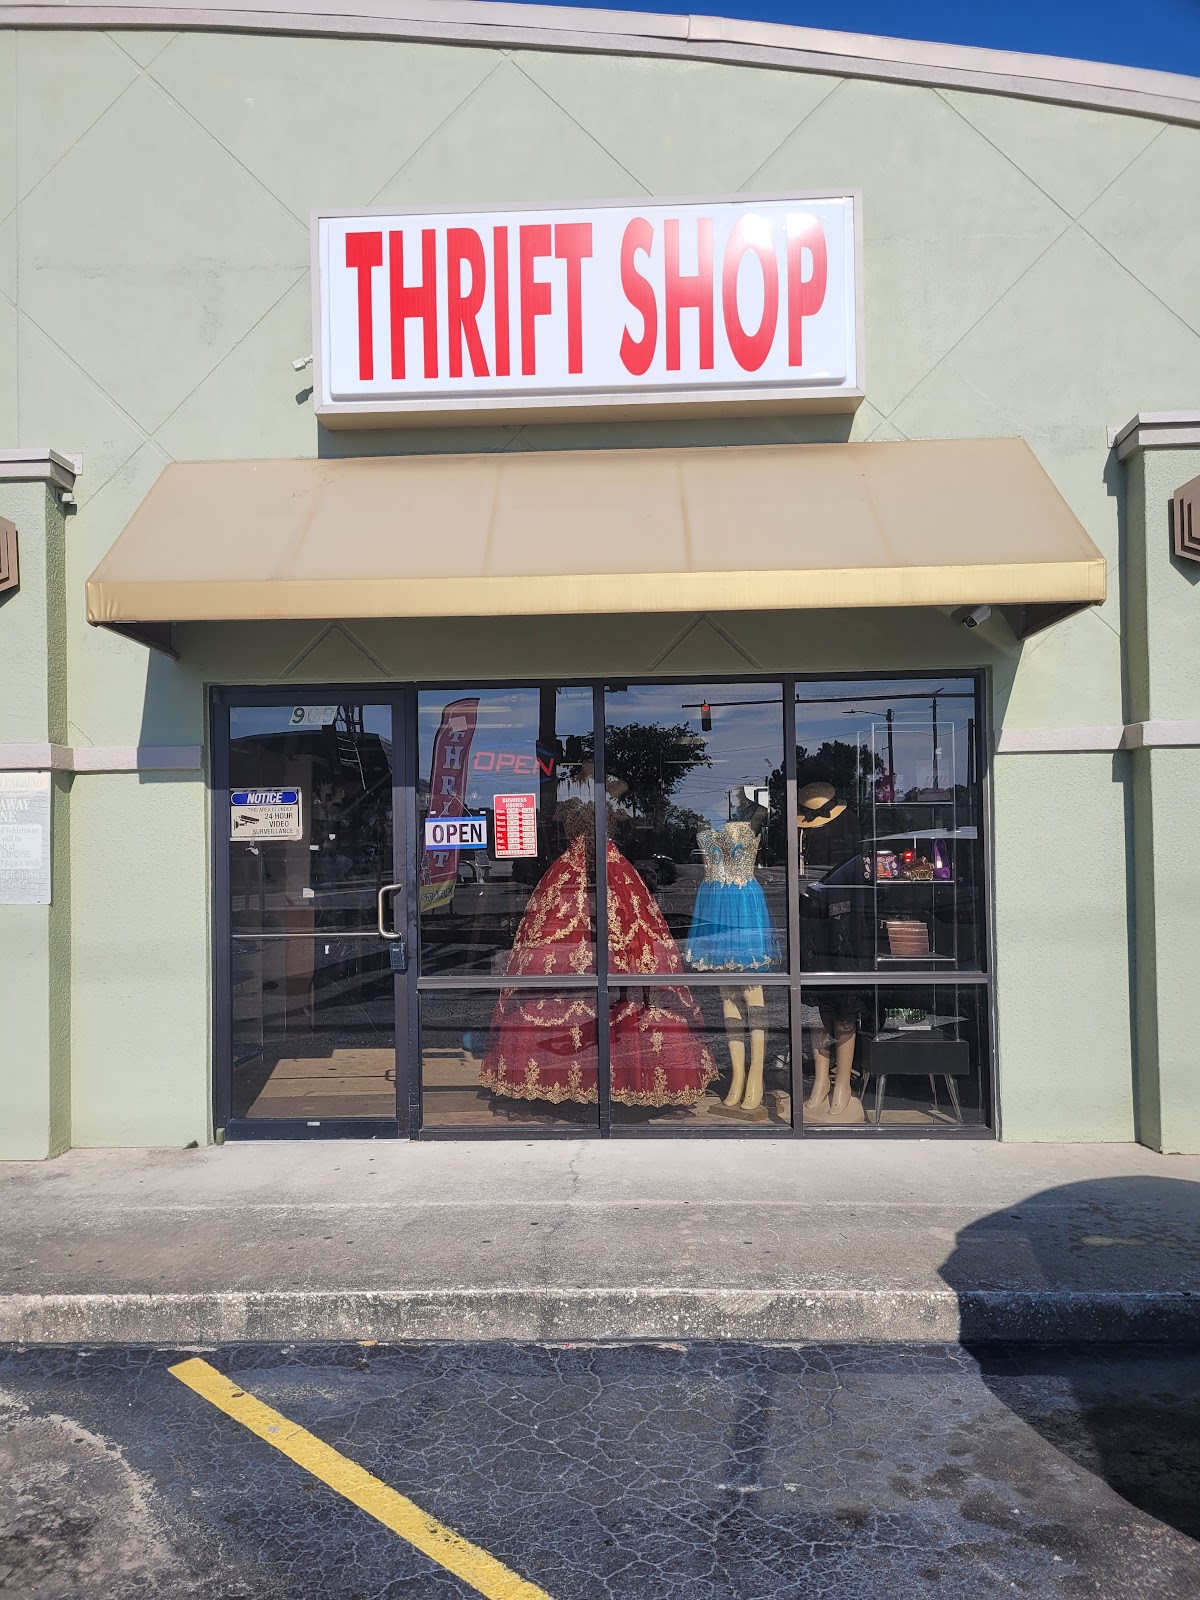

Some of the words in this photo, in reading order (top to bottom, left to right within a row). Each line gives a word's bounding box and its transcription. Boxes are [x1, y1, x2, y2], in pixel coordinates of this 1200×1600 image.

[345, 222, 594, 381] THRIFT
[619, 212, 828, 377] SHOP
[473, 751, 555, 777] OPEN
[246, 792, 283, 804] NOTICE
[274, 812, 294, 820] HOUR
[268, 820, 290, 828] VIDEO
[252, 827, 294, 835] SURVEILLANCE
[432, 823, 482, 844] OPEN
[421, 889, 452, 902] STORE
